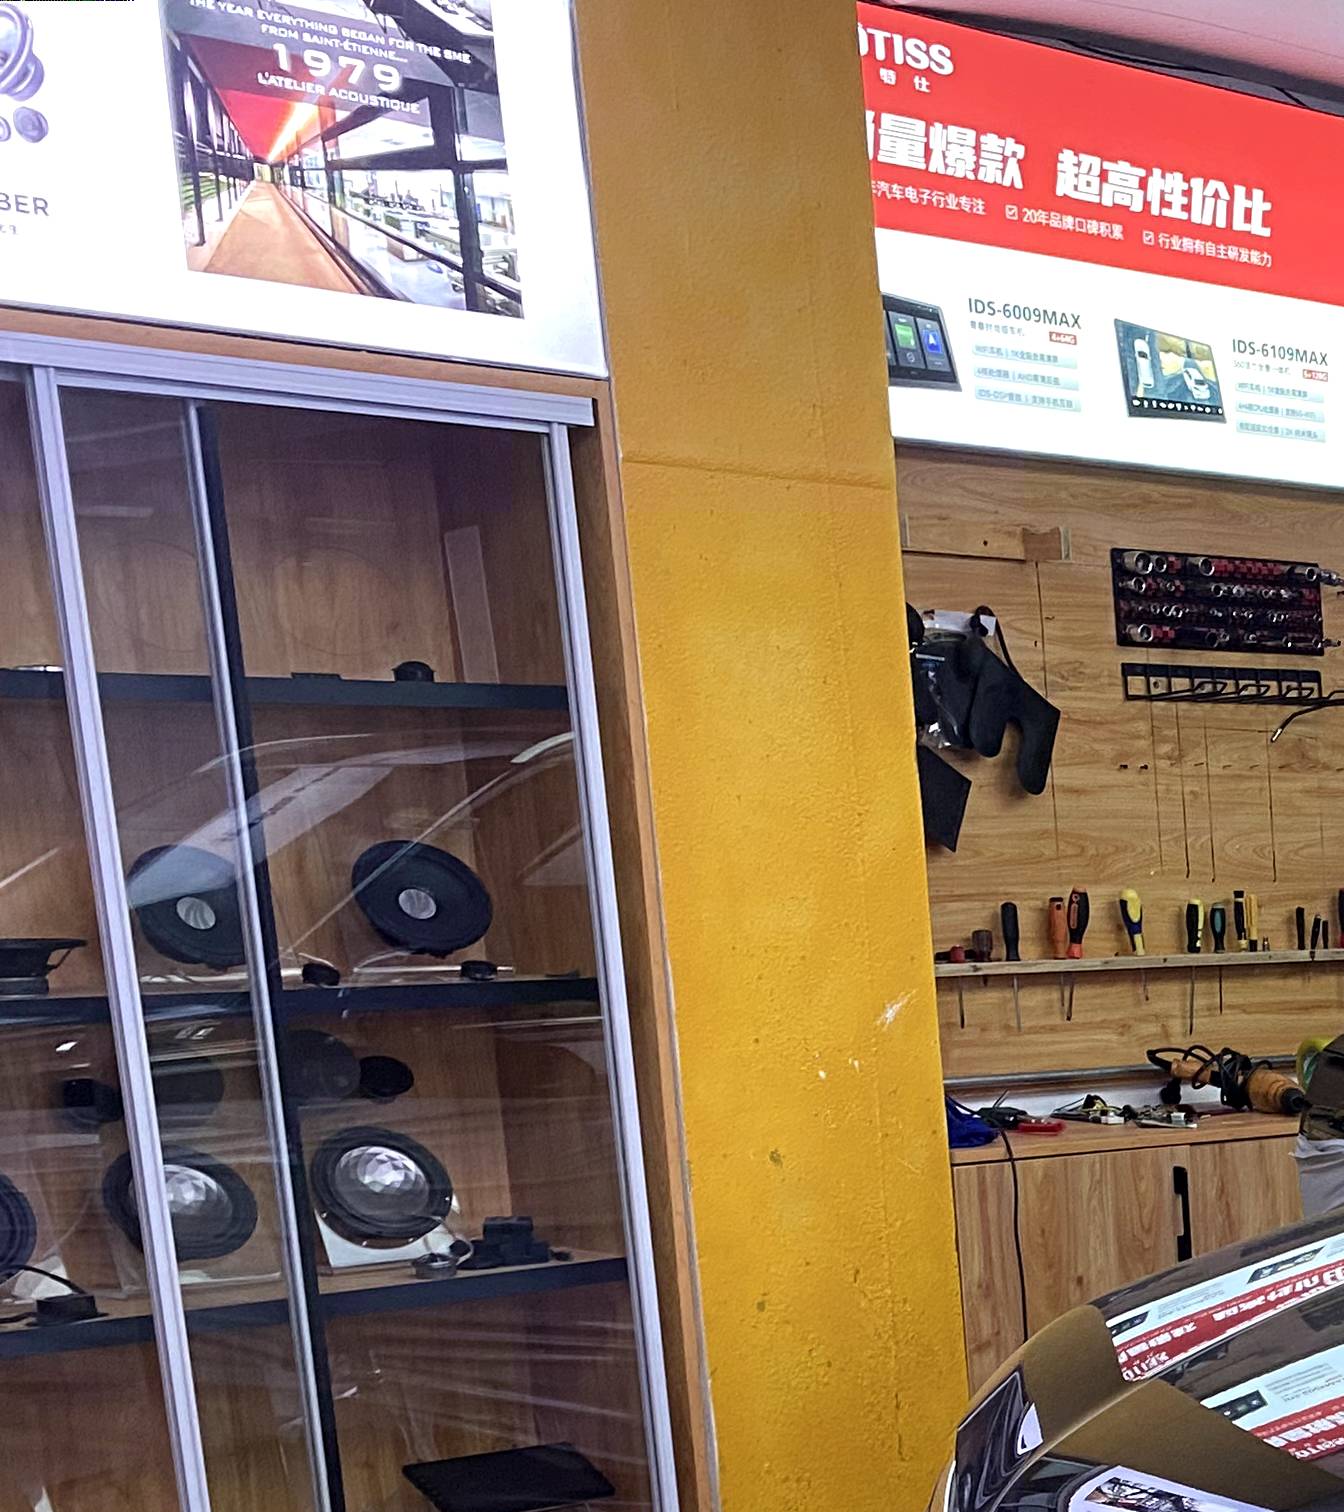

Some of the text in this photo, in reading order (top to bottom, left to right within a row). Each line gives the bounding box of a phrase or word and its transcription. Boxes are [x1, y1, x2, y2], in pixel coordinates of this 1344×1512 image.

[220, 1, 254, 18] YEAR
[257, 10, 338, 35] EVERYTHING
[342, 27, 385, 45] BEGAN
[389, 37, 414, 51] FOR
[261, 24, 299, 40] FROM
[272, 43, 402, 92] 1979
[257, 71, 420, 114] L'ATELIER ACOUSTIQUE
[1056, 147, 1272, 237] 超高性价比
[1022, 207, 1124, 241] 20年品牌口碑积累
[1158, 232, 1272, 268] 行业拥有自主研发能力
[968, 297, 1082, 330] IDS-6009MAX
[1232, 338, 1328, 366] IDS-6109MAX
